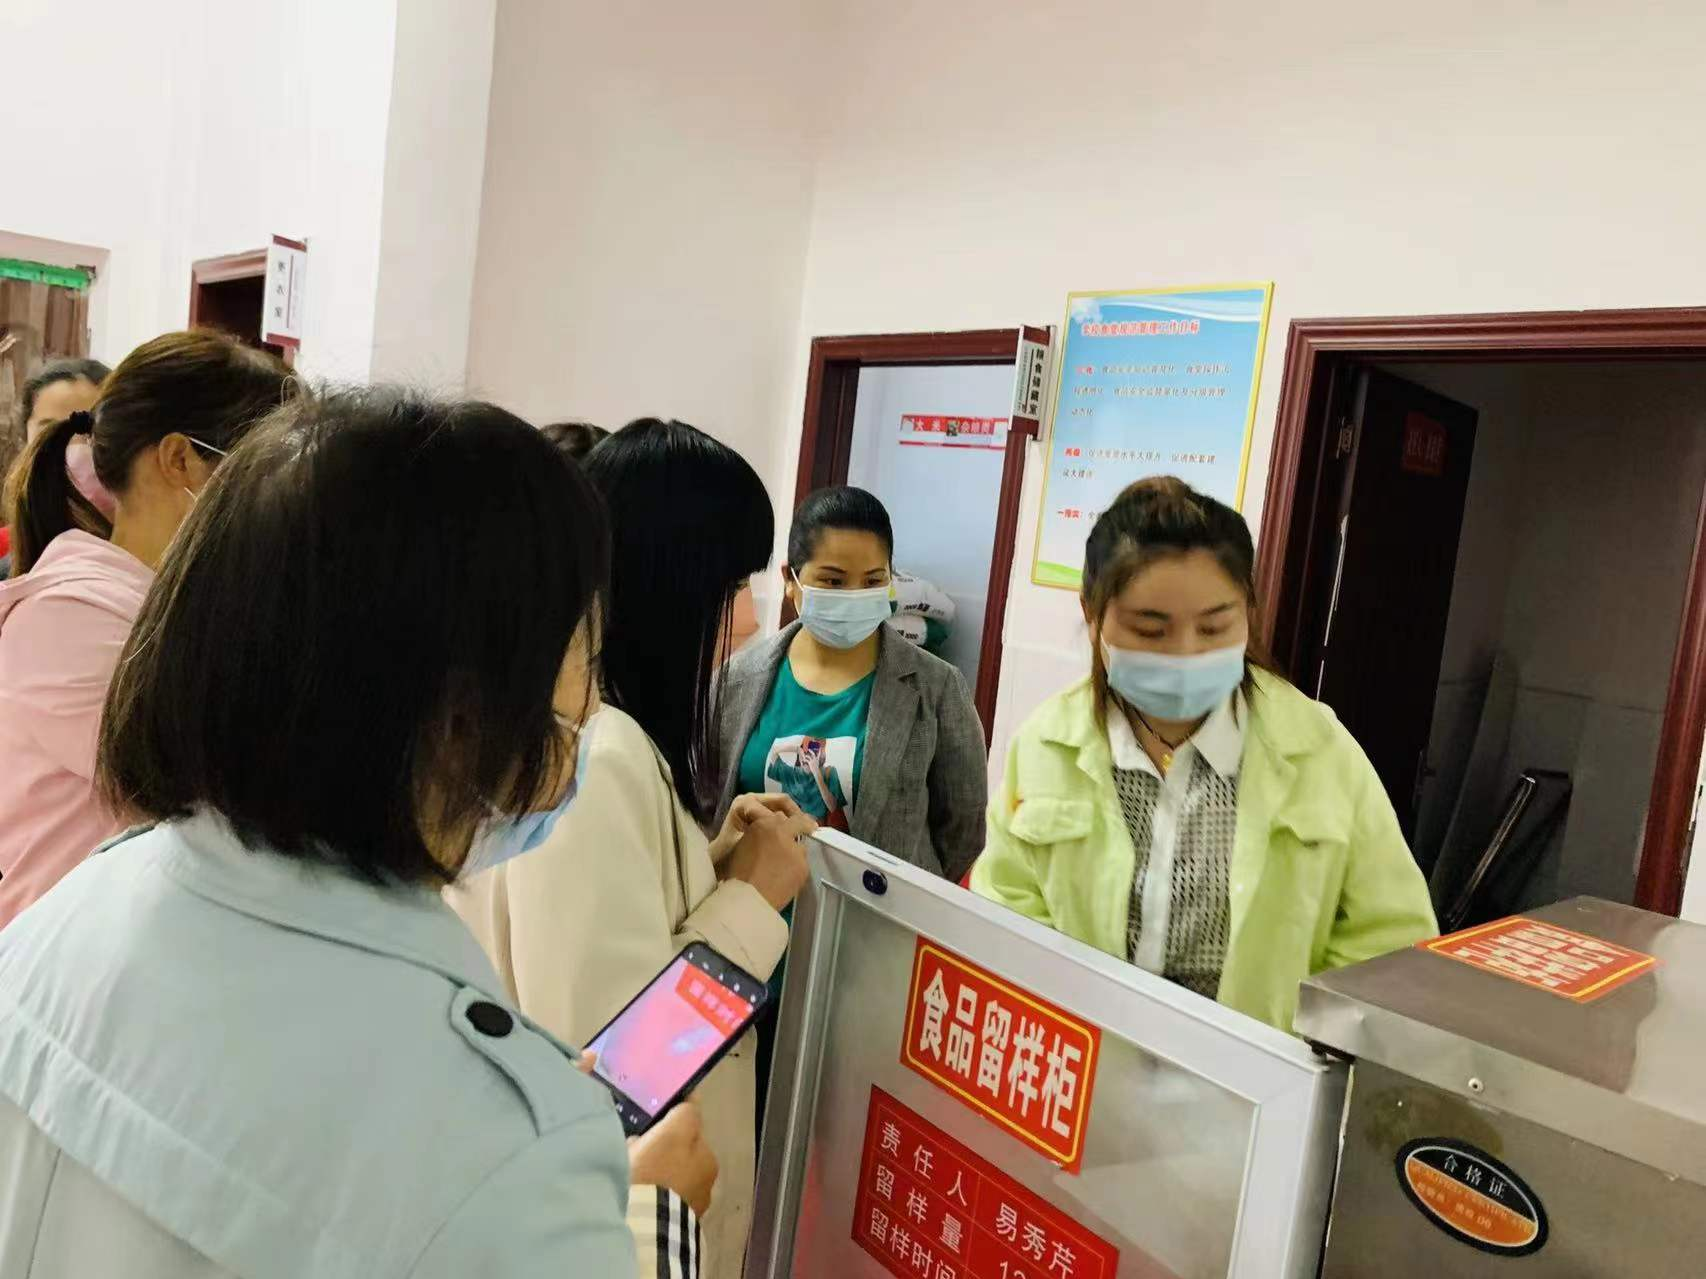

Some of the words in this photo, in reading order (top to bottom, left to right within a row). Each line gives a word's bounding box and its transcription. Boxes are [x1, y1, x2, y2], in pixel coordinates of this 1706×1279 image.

[919, 967, 1081, 1138] 食品留样柜
[880, 1120, 968, 1206] 责任人
[1444, 1154, 1505, 1198] 合格证
[876, 1163, 963, 1254] 留样量
[996, 1202, 1076, 1279] 易秀芹
